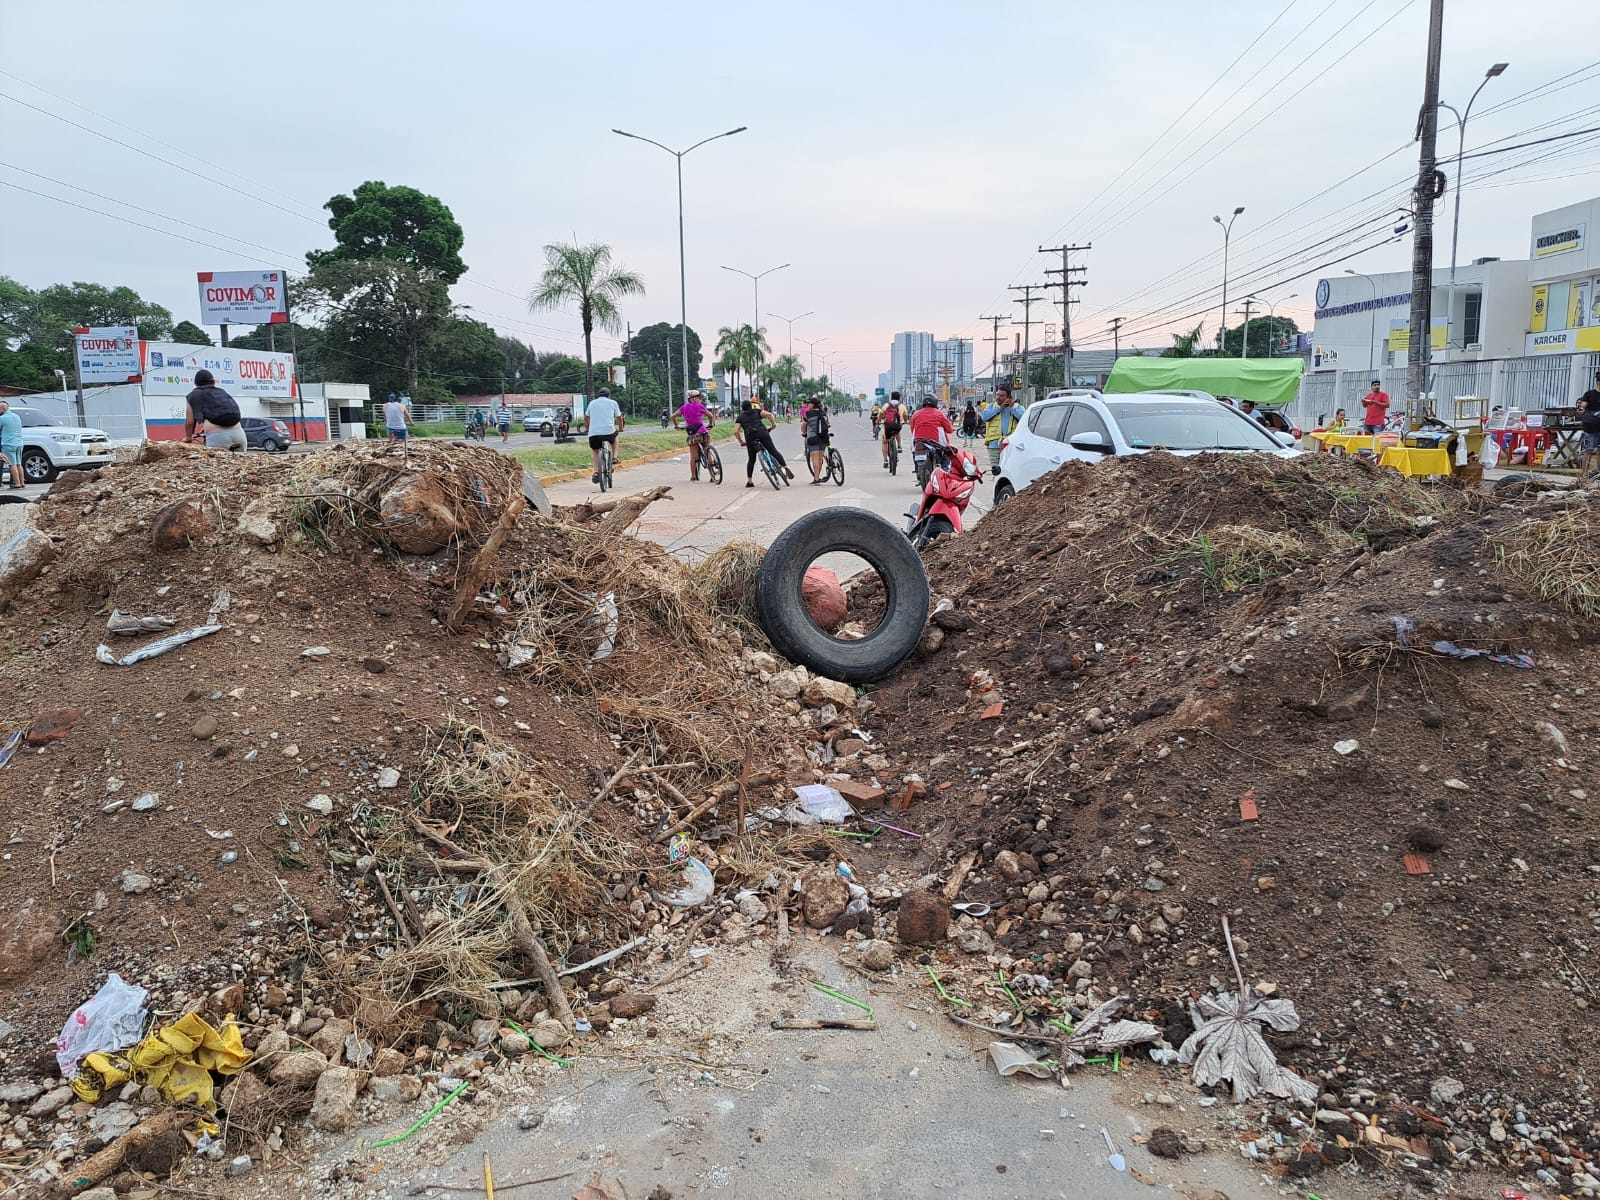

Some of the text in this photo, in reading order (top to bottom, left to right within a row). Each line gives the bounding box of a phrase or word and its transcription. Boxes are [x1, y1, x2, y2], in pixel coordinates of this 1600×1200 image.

[206, 284, 276, 304] COVIMOR
[82, 337, 133, 351] COVIMOR
[239, 359, 287, 382] COVIMOR
